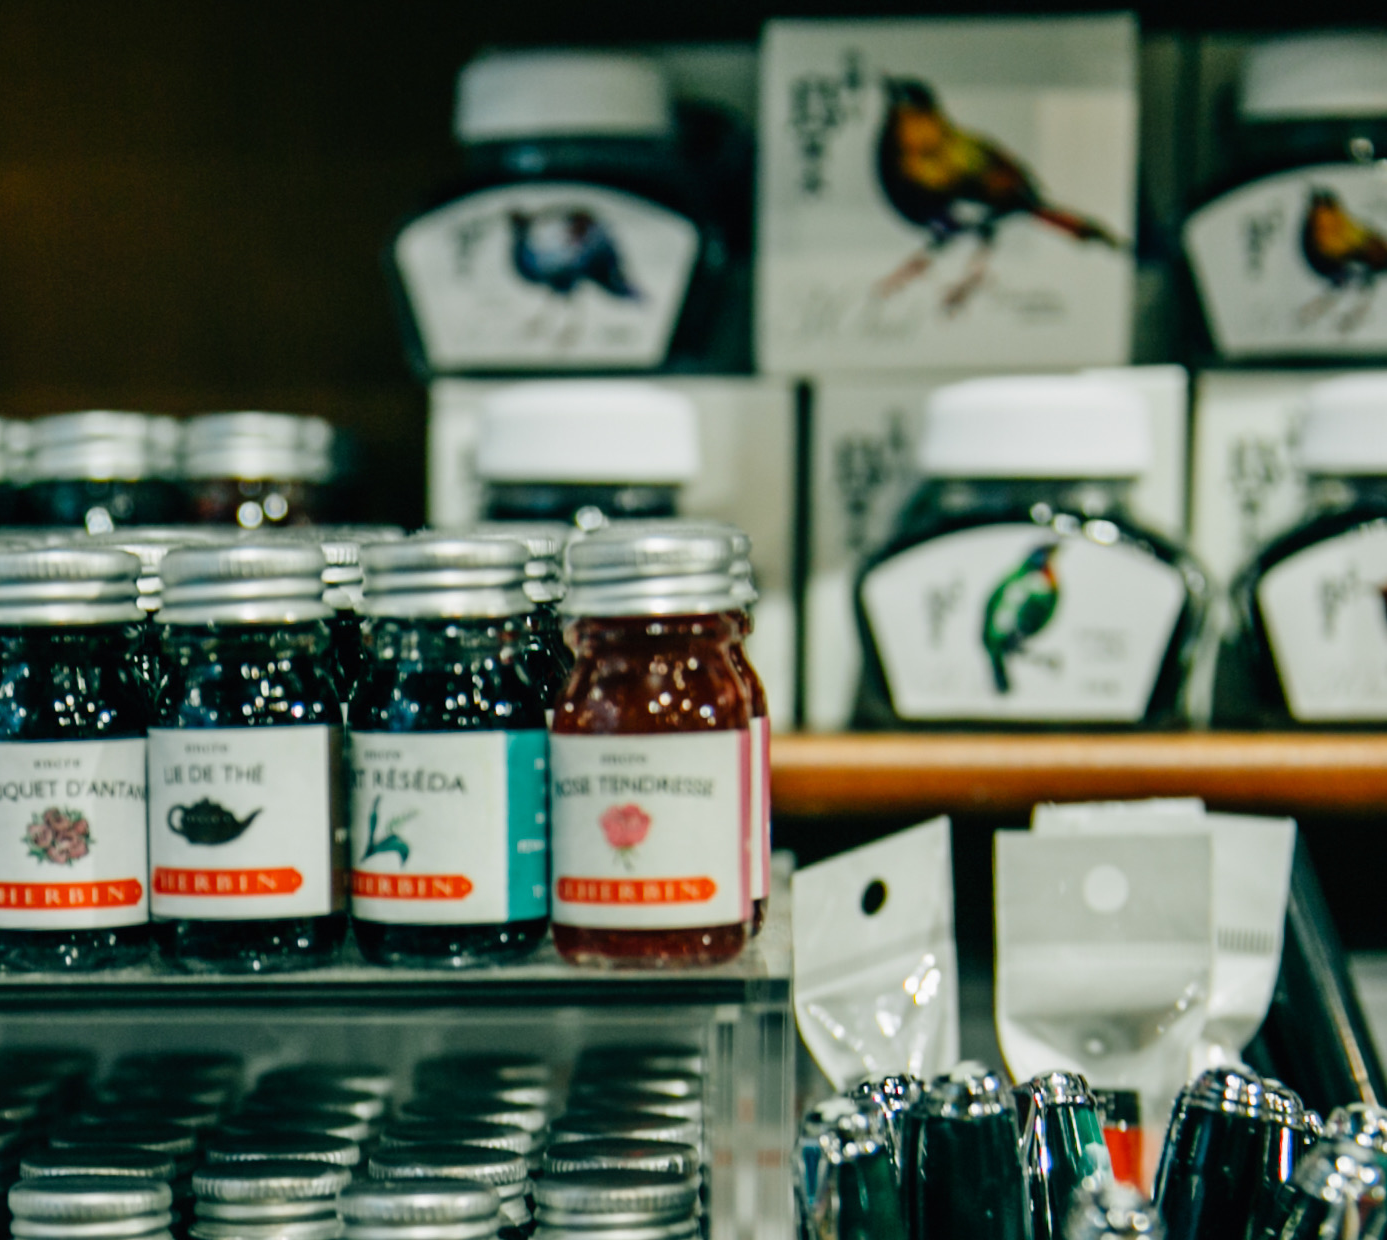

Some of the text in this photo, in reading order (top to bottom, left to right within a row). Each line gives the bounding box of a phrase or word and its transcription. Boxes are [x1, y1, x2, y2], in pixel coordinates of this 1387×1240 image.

[188, 764, 214, 783] DE
[221, 764, 264, 783] THÉ
[370, 764, 468, 795] RÉSÉDA
[598, 774, 715, 798] TENDRESSE
